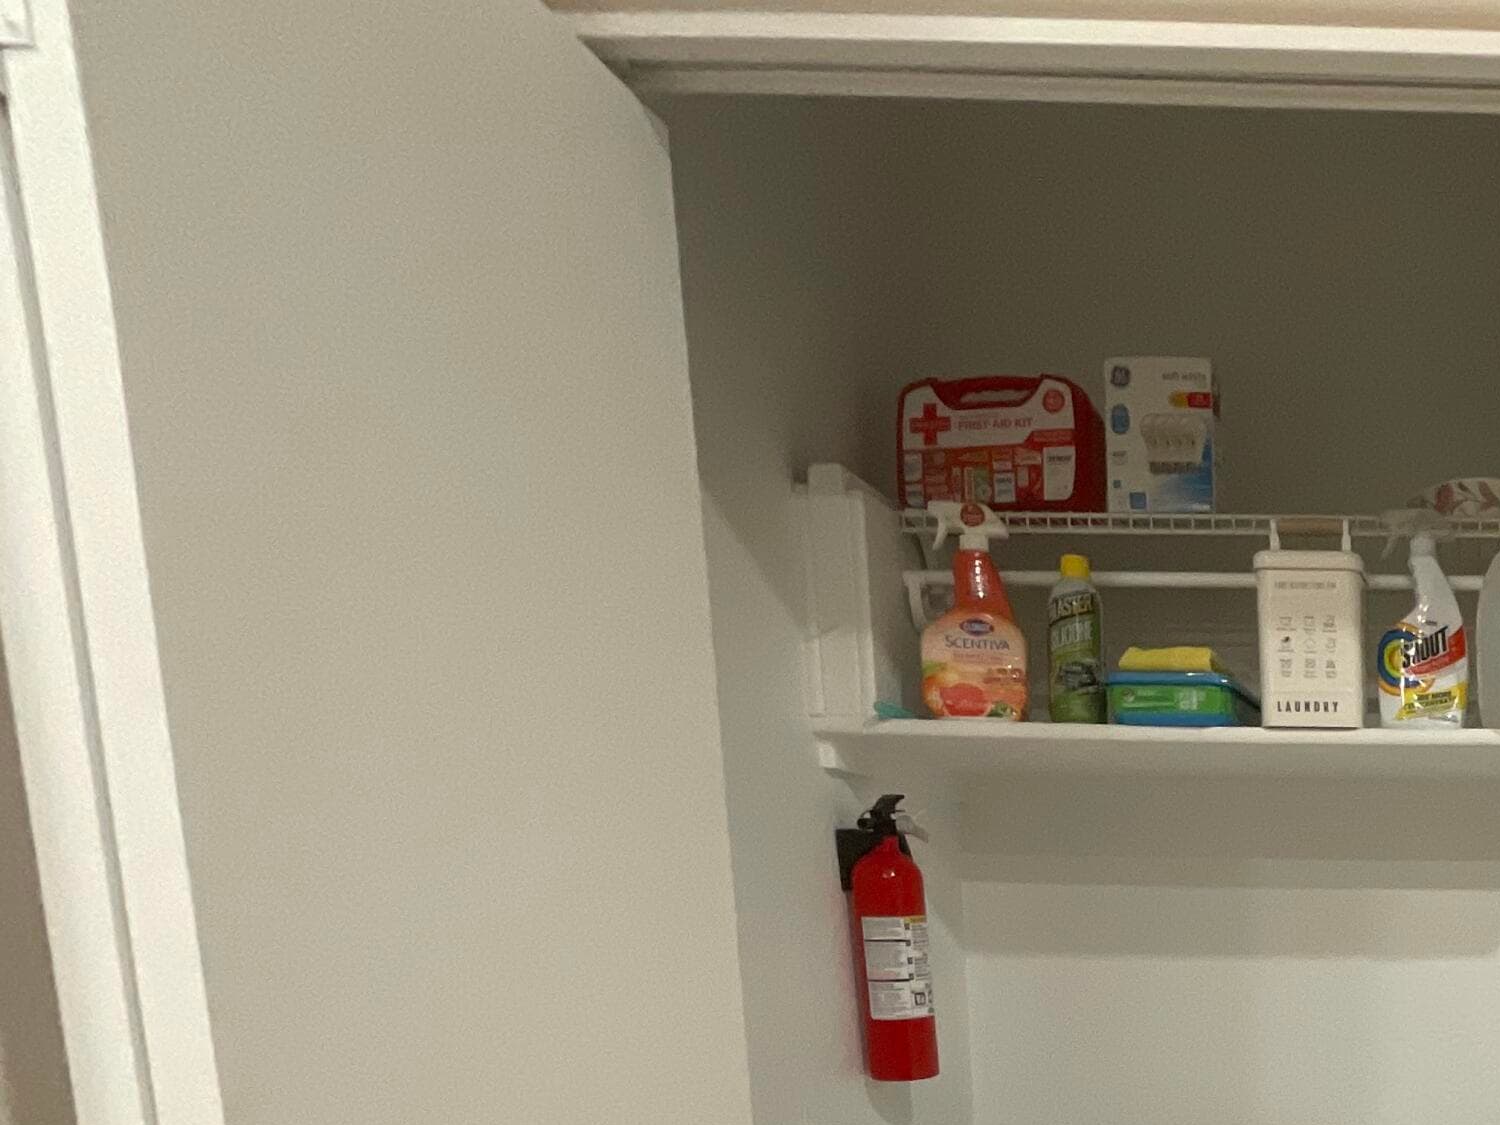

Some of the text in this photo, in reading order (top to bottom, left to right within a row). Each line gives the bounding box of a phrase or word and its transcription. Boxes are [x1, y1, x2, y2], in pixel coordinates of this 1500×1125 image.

[992, 418, 1012, 429] AID
[1014, 417, 1033, 428] KIT
[943, 634, 1010, 651] SCENTIVA
[1277, 700, 1338, 712] LAUNDRY
